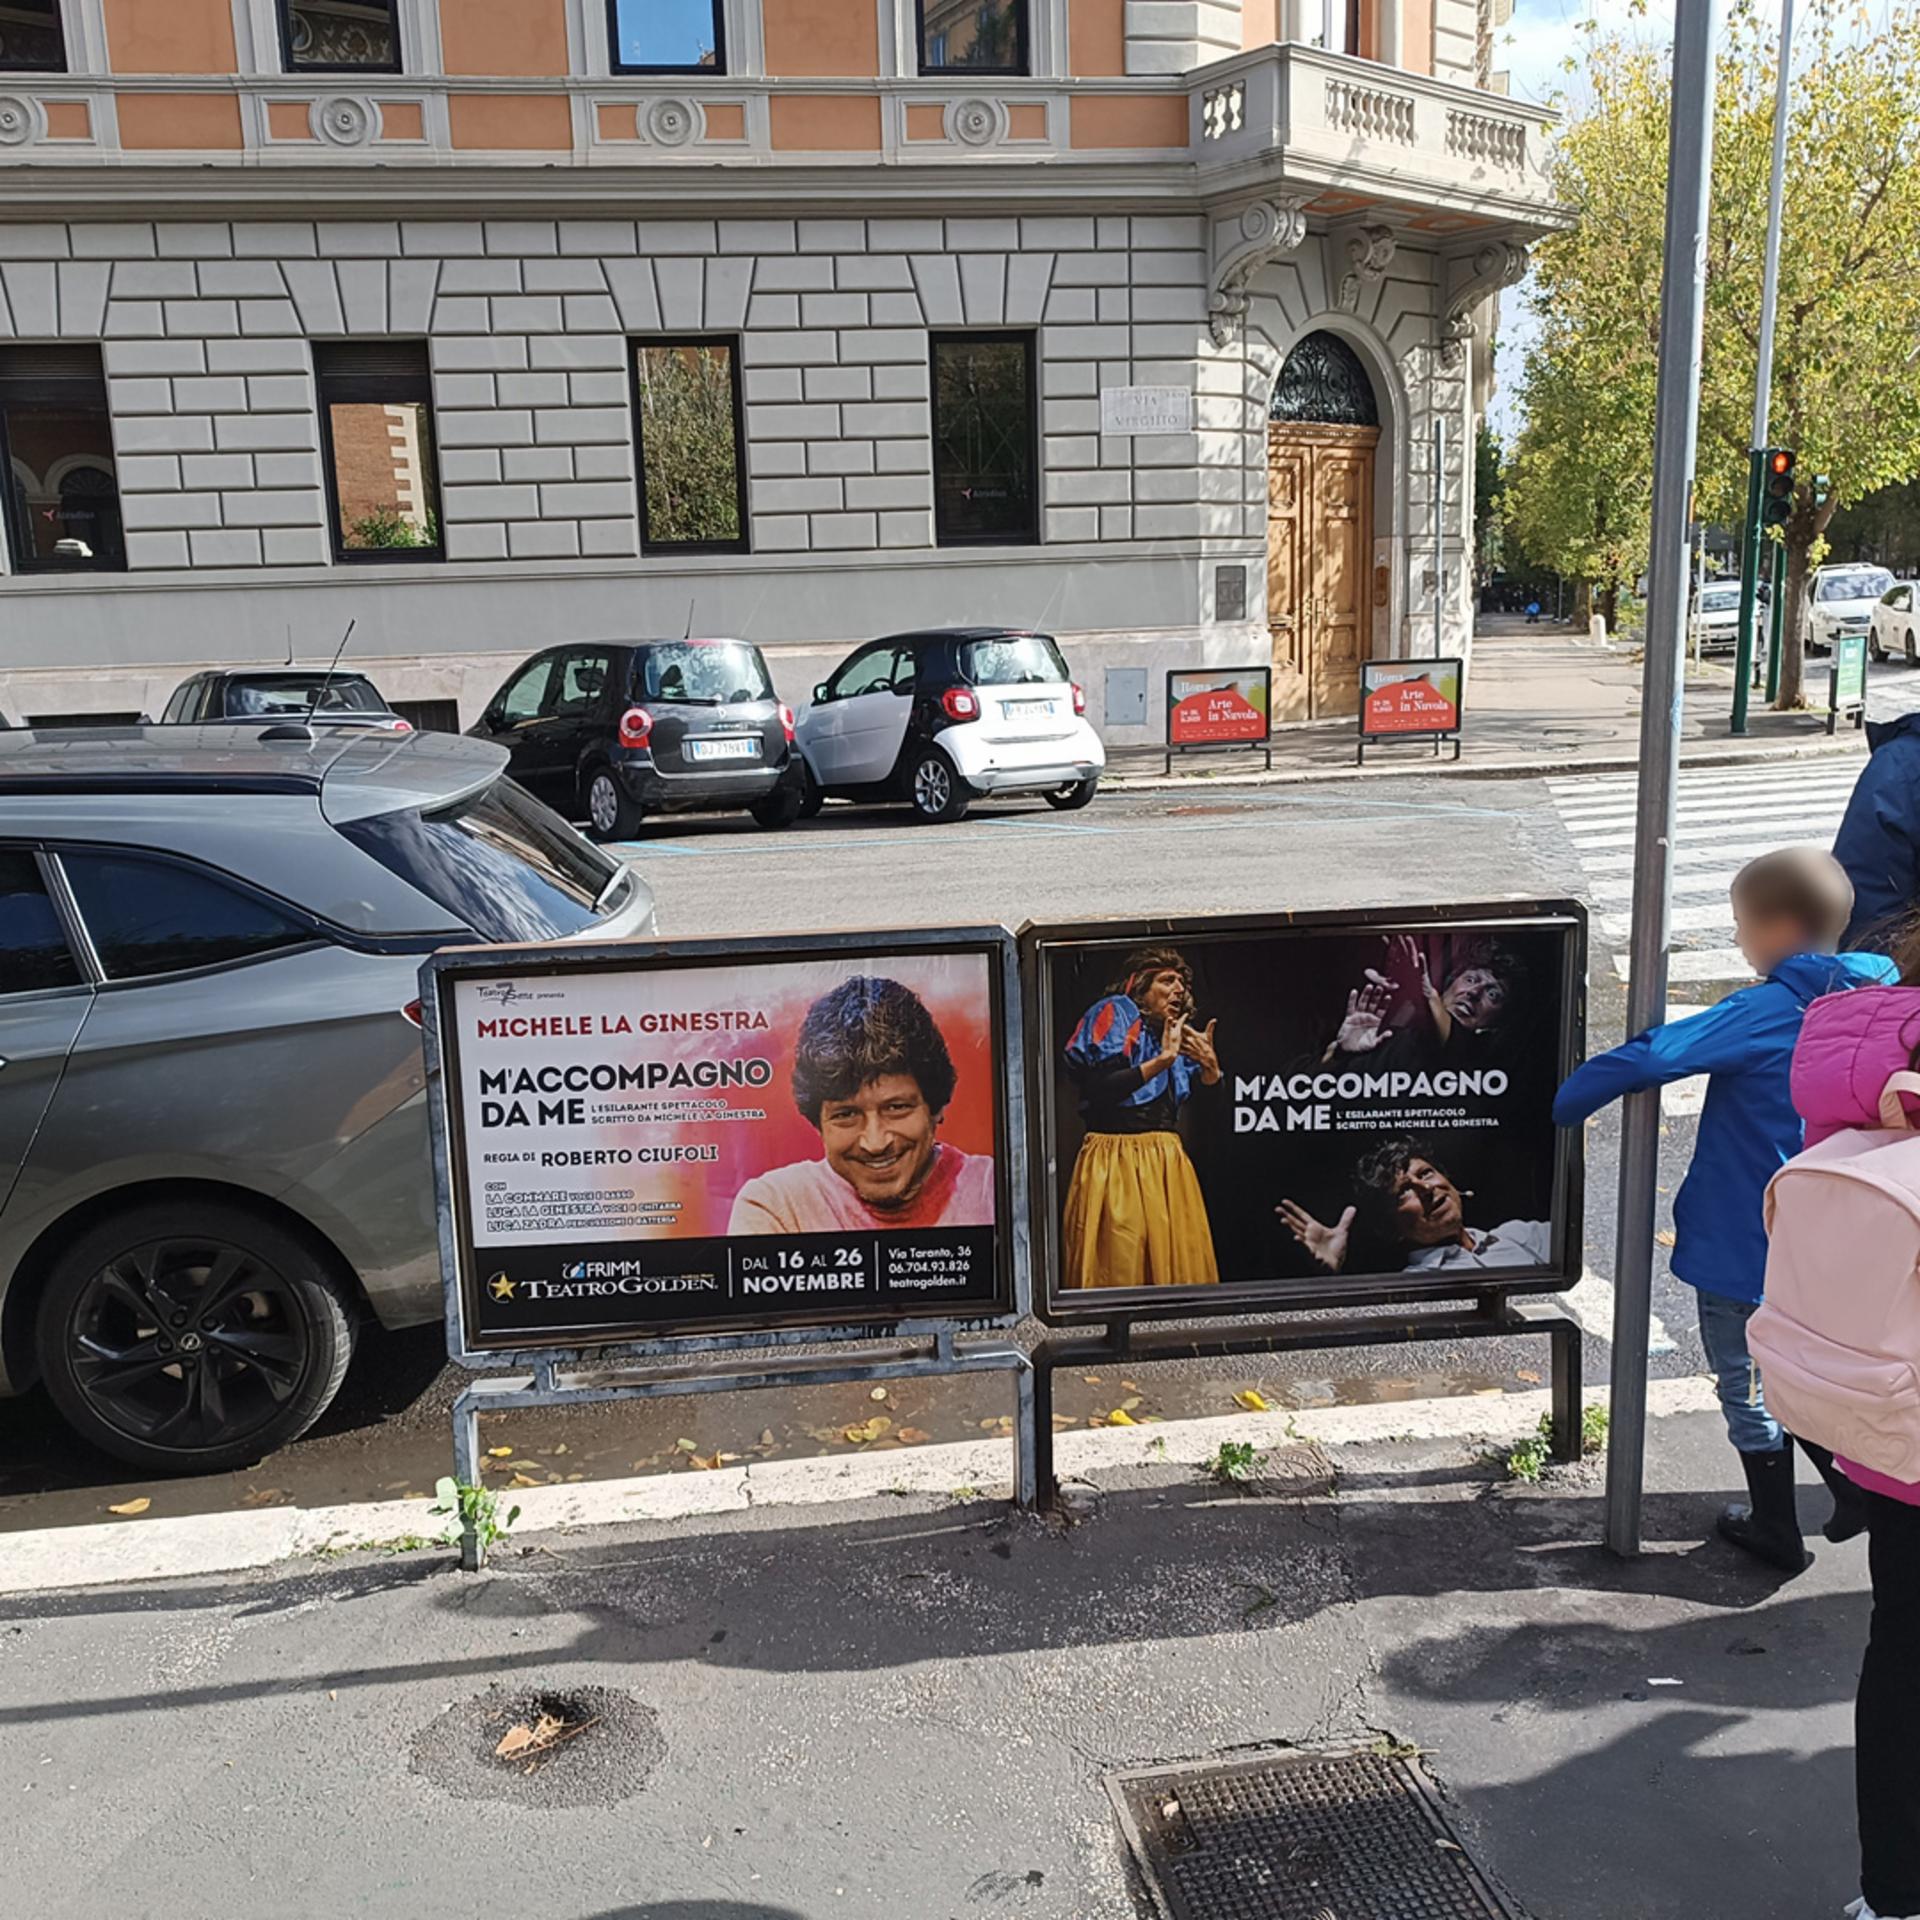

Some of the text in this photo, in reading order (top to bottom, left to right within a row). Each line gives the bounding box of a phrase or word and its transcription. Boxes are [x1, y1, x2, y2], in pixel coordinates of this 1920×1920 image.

[1134, 395, 1157, 405] VIA
[1400, 689, 1425, 700] Arte
[1208, 699, 1233, 710] Arte
[1400, 700, 1411, 712] in
[1413, 699, 1449, 711] Nuvola
[1208, 710, 1219, 722] in
[1222, 708, 1258, 721] Nuvola
[477, 1011, 769, 1039] MICHELE LA GINESTRA
[479, 1059, 772, 1096] M'ACCOMPAGNO
[1234, 1069, 1509, 1102] M'ACCOMPAGNO
[661, 1100, 727, 1110] SPETTACOLO
[481, 1098, 585, 1128] DA ME
[591, 1110, 766, 1124] SCRITTO DA MICHELE LA GINESTRA
[1234, 1104, 1331, 1132] DA ME
[1404, 1108, 1466, 1117] SPETTACOLO
[1336, 1118, 1499, 1130] SCRITTO DA MICHELE LA GINESTRA
[484, 1146, 718, 1167] REGIA DI ROBERTO CIUFOLI
[485, 1193, 503, 1205] LA
[486, 1206, 522, 1218] LUCA
[522, 1205, 539, 1217] LA
[540, 1202, 601, 1216] GINESTRA
[487, 1220, 522, 1232] LUCA
[742, 1248, 863, 1270] DAL 16 AL 26
[888, 1245, 972, 1259] Via Taranto, 36
[586, 1260, 641, 1279] FRIMM
[888, 1260, 970, 1274] 06.704.93.826
[743, 1272, 865, 1294] NOVEMBRE
[888, 1275, 967, 1290] teatrogolden.it
